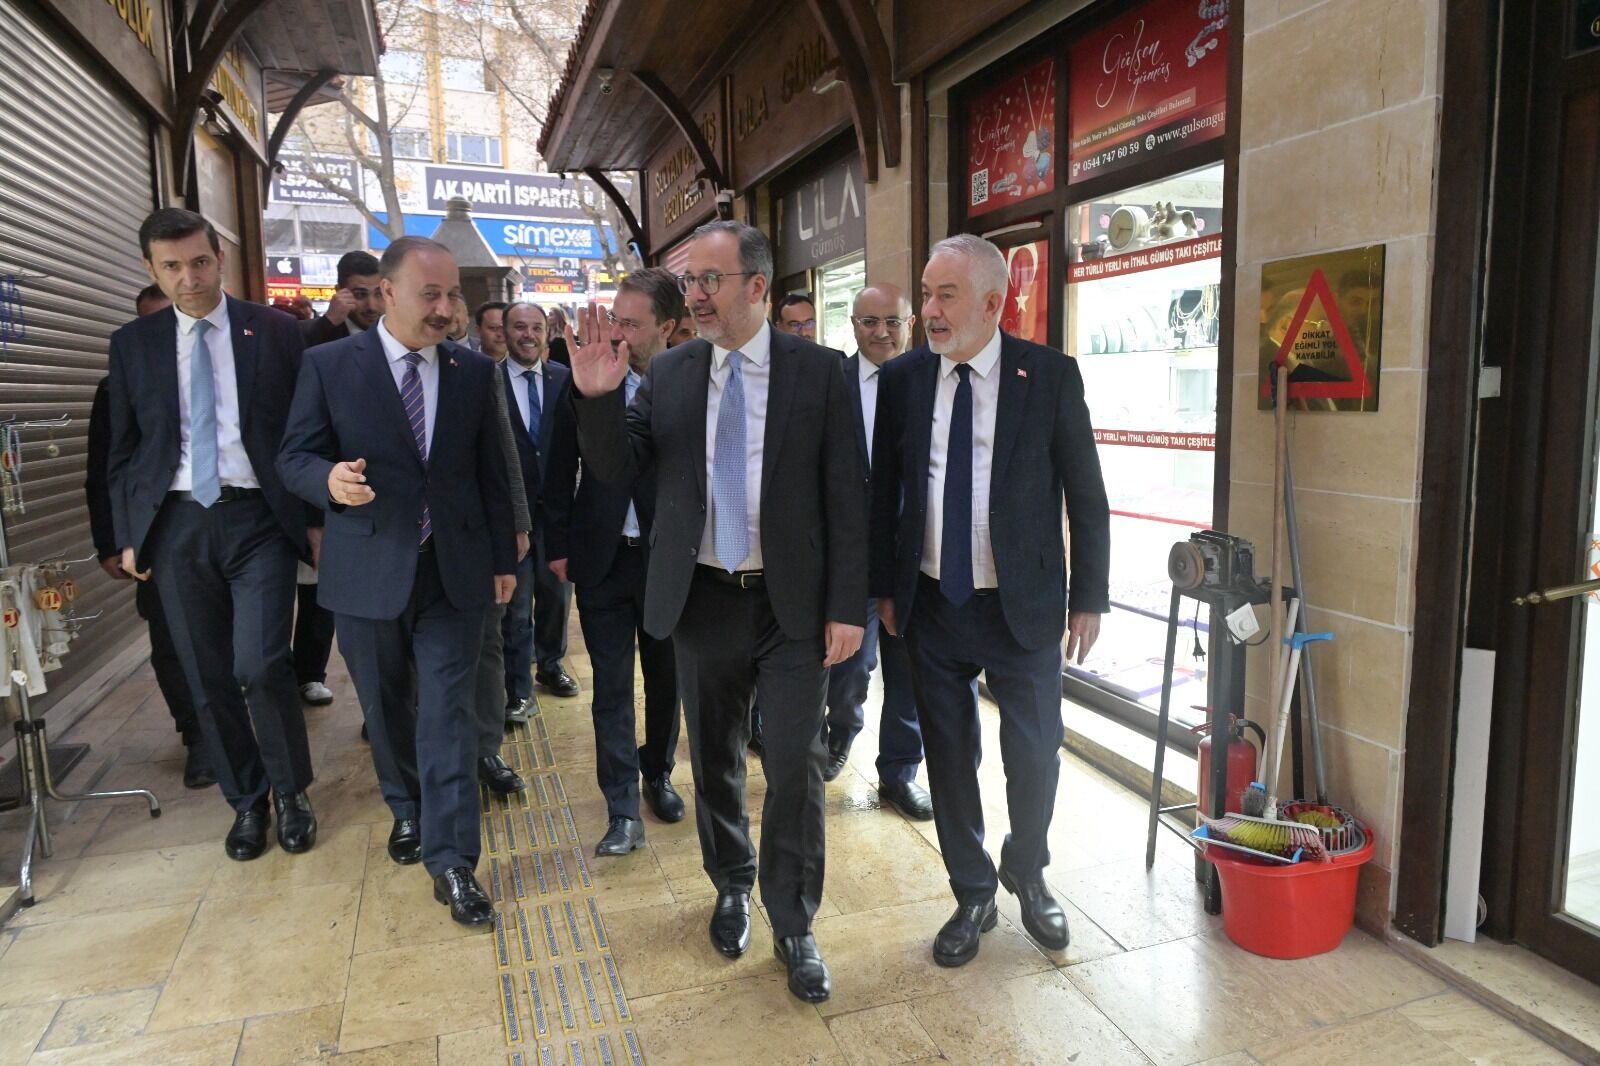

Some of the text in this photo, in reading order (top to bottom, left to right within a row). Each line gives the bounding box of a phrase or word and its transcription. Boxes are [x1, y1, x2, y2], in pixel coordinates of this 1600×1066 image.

[1156, 110, 1226, 145] www.gulsengu
[1082, 142, 1140, 172] 0544 747 60 59
[433, 179, 458, 200] AK
[462, 179, 511, 205] PARTİ
[514, 185, 582, 210] ISPARTA
[1073, 268, 1085, 278] HER
[1086, 264, 1104, 276] TÜRLÜ
[1104, 260, 1122, 273] YERLİ
[1122, 262, 1130, 270] ve
[1130, 255, 1148, 268] İTHAL
[1150, 250, 1174, 264] GÜMÜŞ
[1175, 248, 1191, 258] TAKI
[1295, 340, 1336, 350] EĞİMLİ YOL
[1302, 330, 1330, 340] DİKKAT
[1296, 350, 1336, 360] KAYABİLİR
[1103, 432, 1119, 441] YERLİ
[1127, 432, 1145, 444] İTHAL
[1146, 434, 1169, 446] GÜMÜŞ
[1170, 436, 1186, 446] TAKI
